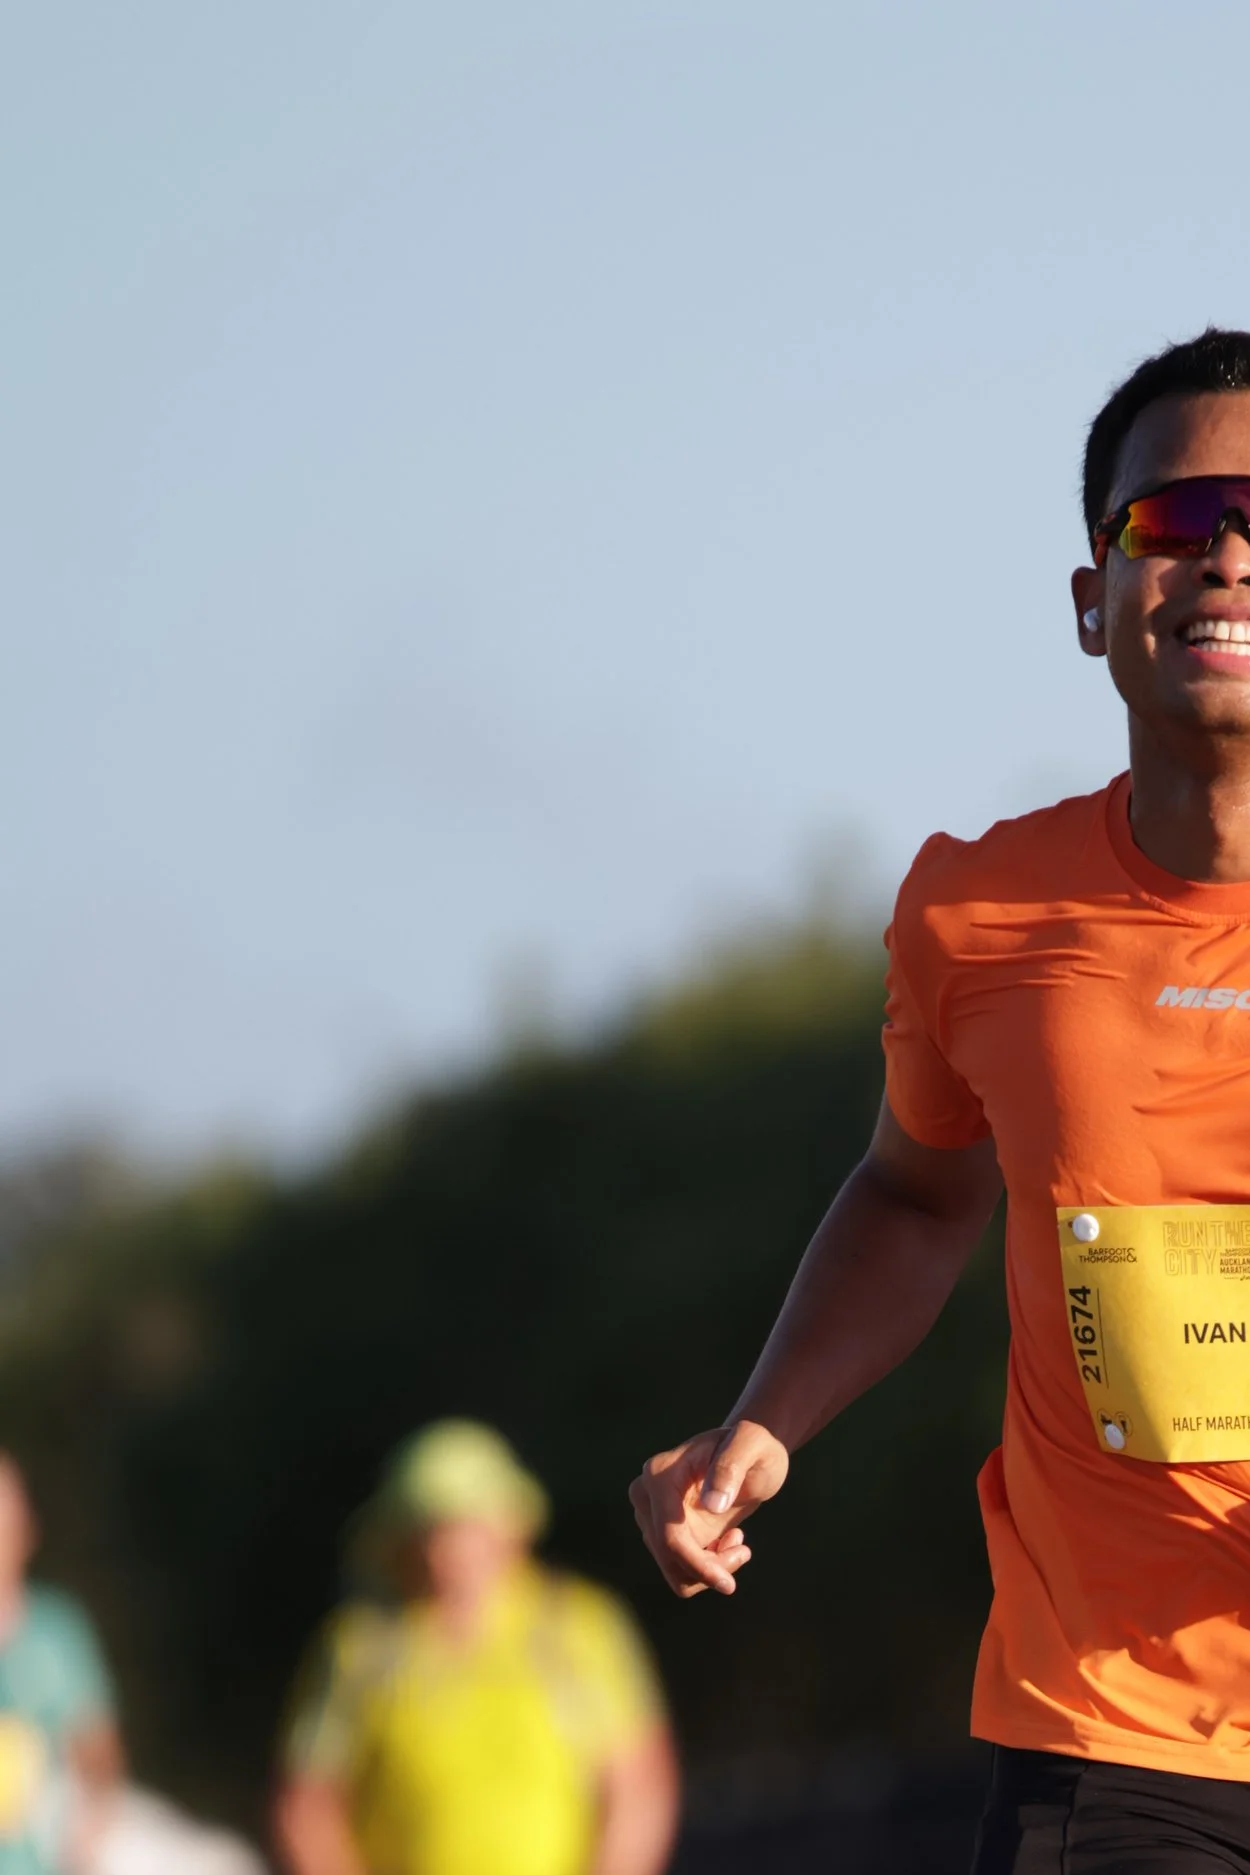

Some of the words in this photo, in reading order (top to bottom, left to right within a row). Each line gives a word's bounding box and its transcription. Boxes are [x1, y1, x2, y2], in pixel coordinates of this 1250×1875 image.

[1163, 1220, 1208, 1247] RUN
[1079, 1255, 1126, 1263] THOMPSON
[1088, 1247, 1126, 1255] BARFOOT
[1165, 1248, 1217, 1276] CITY
[1068, 1285, 1101, 1383] 21674
[1184, 1322, 1246, 1344] IVAN
[1172, 1417, 1202, 1432] HALF
